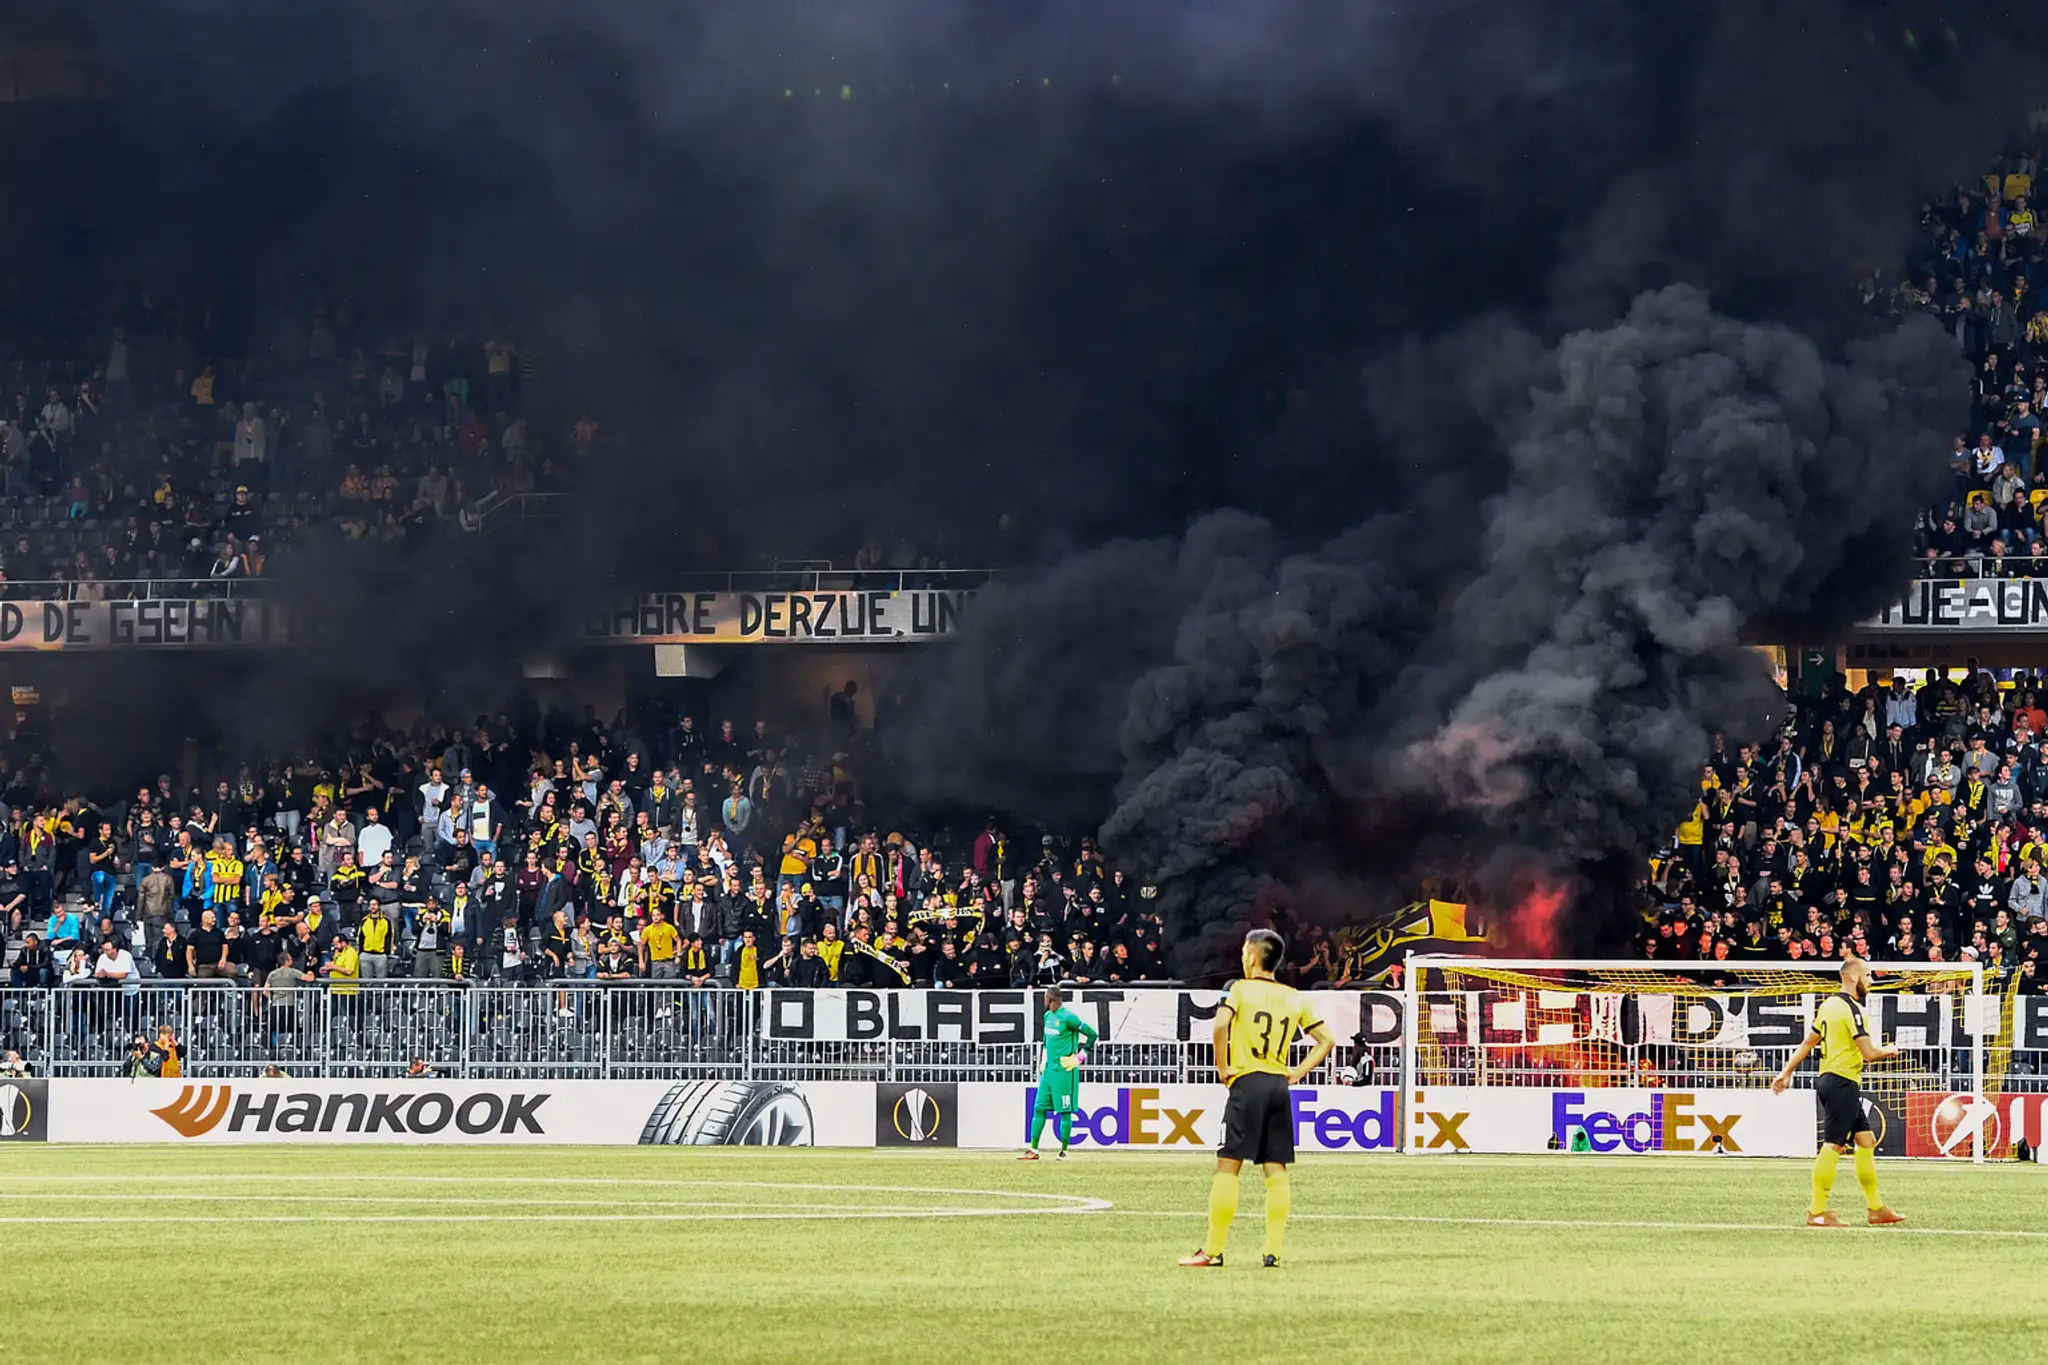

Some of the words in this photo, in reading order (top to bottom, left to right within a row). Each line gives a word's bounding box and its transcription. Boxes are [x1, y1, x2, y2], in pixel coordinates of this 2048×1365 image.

[43, 601, 91, 643] DE
[110, 600, 243, 644] GSEHN
[769, 990, 814, 1040] O
[1251, 1010, 1289, 1061] 31
[1552, 1091, 1744, 1153] FedEx
